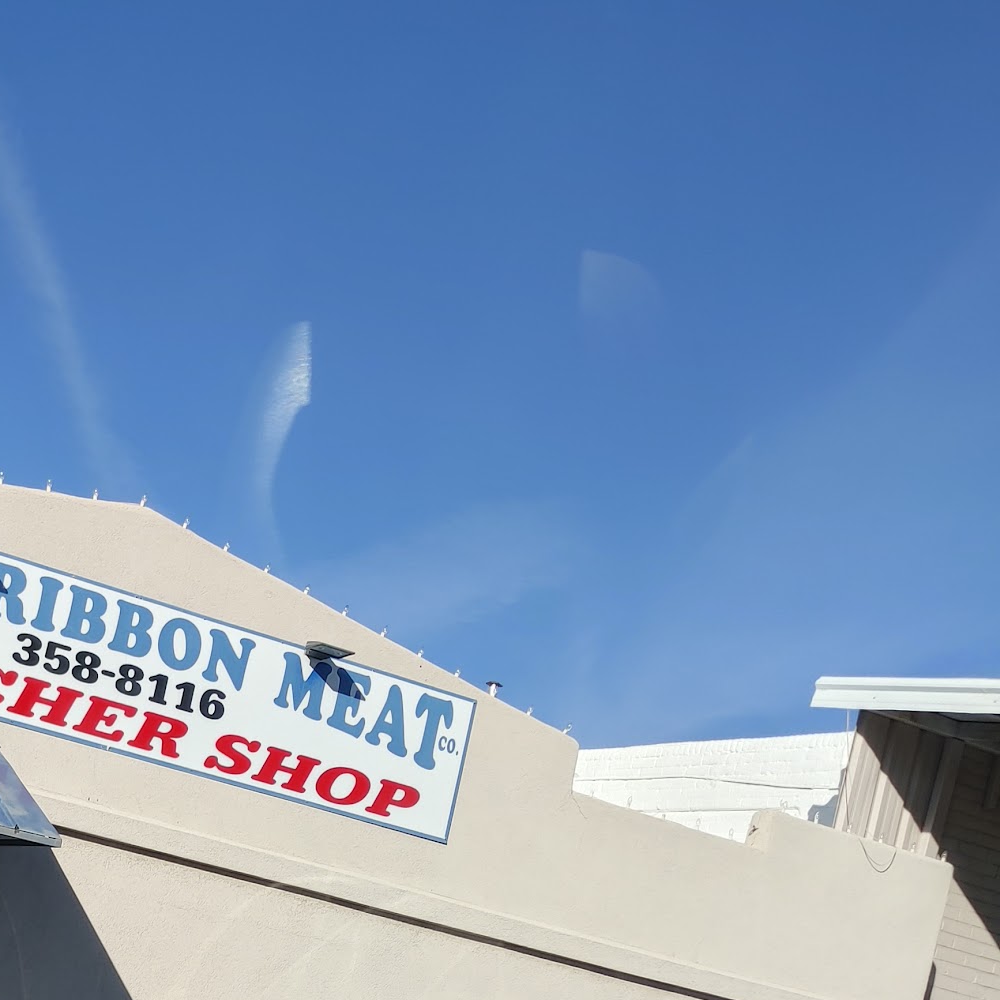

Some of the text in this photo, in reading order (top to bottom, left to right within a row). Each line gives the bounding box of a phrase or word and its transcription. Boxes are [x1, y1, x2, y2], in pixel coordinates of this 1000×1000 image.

[12, 633, 226, 720] 358-8116
[274, 649, 453, 770] MEAT
[438, 733, 459, 757] CO.
[204, 734, 420, 817] SHOP
